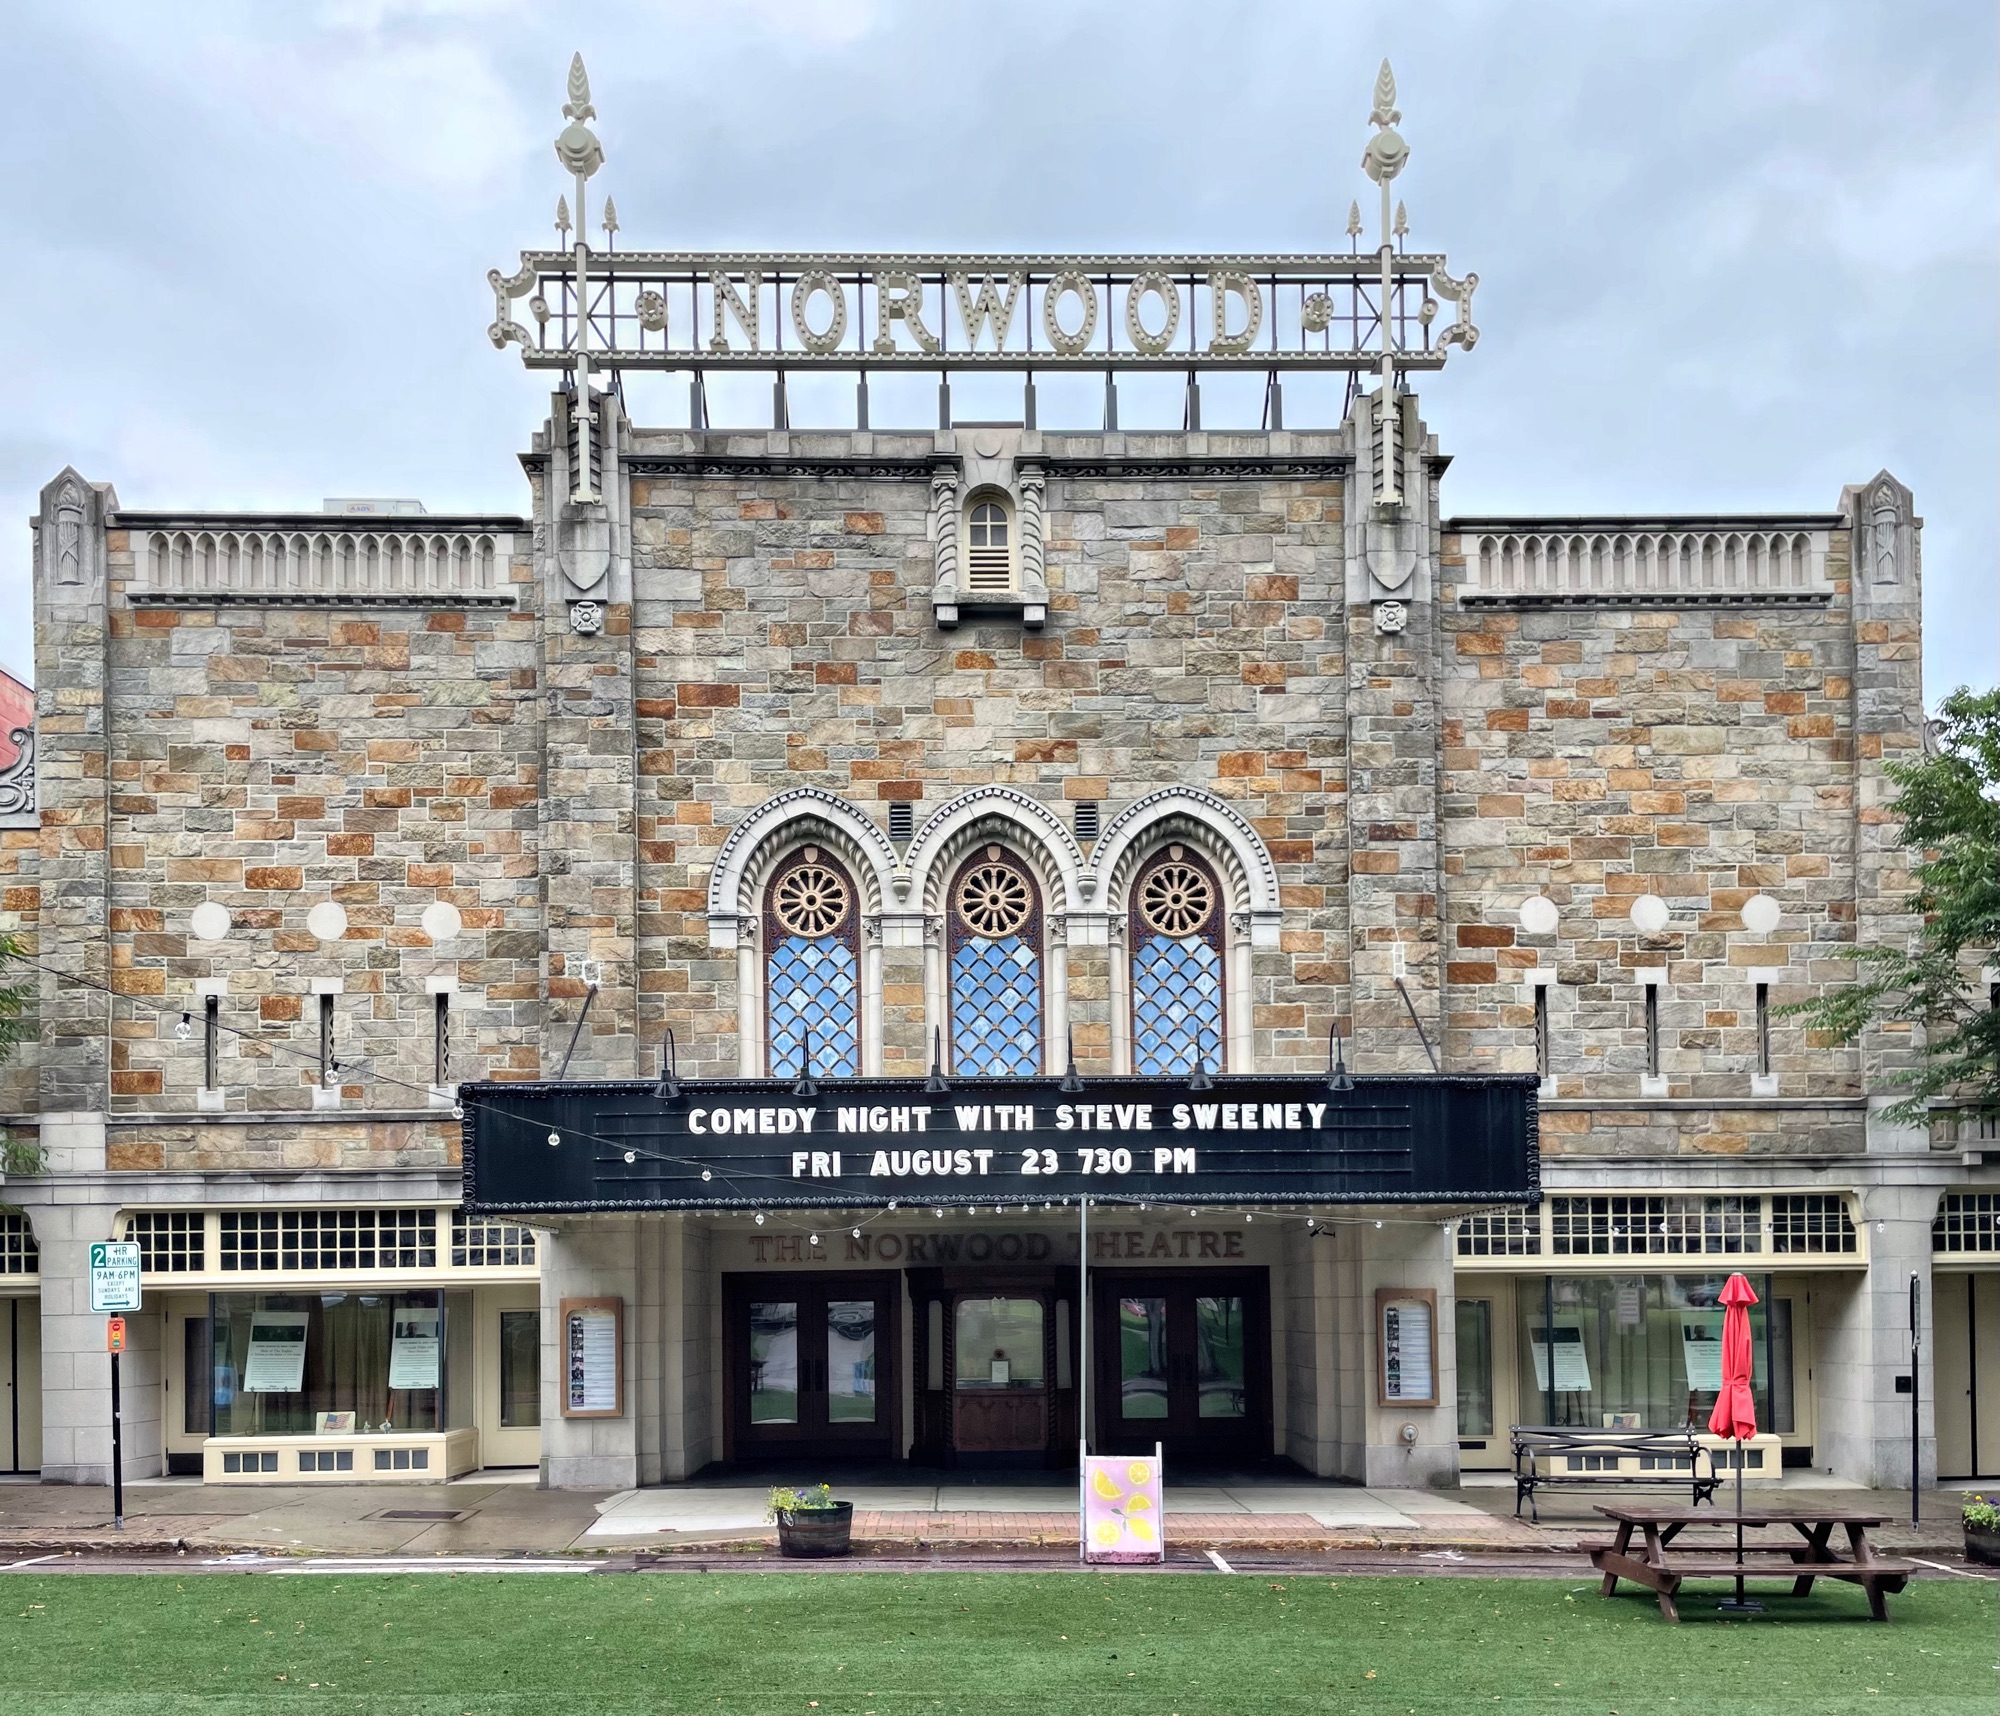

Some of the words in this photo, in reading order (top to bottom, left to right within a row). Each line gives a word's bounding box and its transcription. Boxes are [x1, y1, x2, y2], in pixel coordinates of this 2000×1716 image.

[708, 267, 1264, 353] NORWOOD
[688, 1107, 817, 1134] COMEDY
[837, 1106, 931, 1133] NIGHT
[954, 1105, 1034, 1131] WITH
[1055, 1104, 1152, 1130] STEVE
[1172, 1103, 1326, 1130] SWEENEY
[792, 1151, 841, 1177] FRI
[869, 1149, 994, 1176] AUGUST
[1020, 1148, 1059, 1174] 23
[1077, 1147, 1132, 1174] 730
[1154, 1147, 1196, 1174] PM
[93, 1247, 105, 1267] 2
[107, 1256, 137, 1266] PARKING
[115, 1246, 128, 1256] HR
[750, 1234, 828, 1263] THE
[844, 1233, 1051, 1262] NORWOOD
[1067, 1230, 1245, 1260] THEATRE
